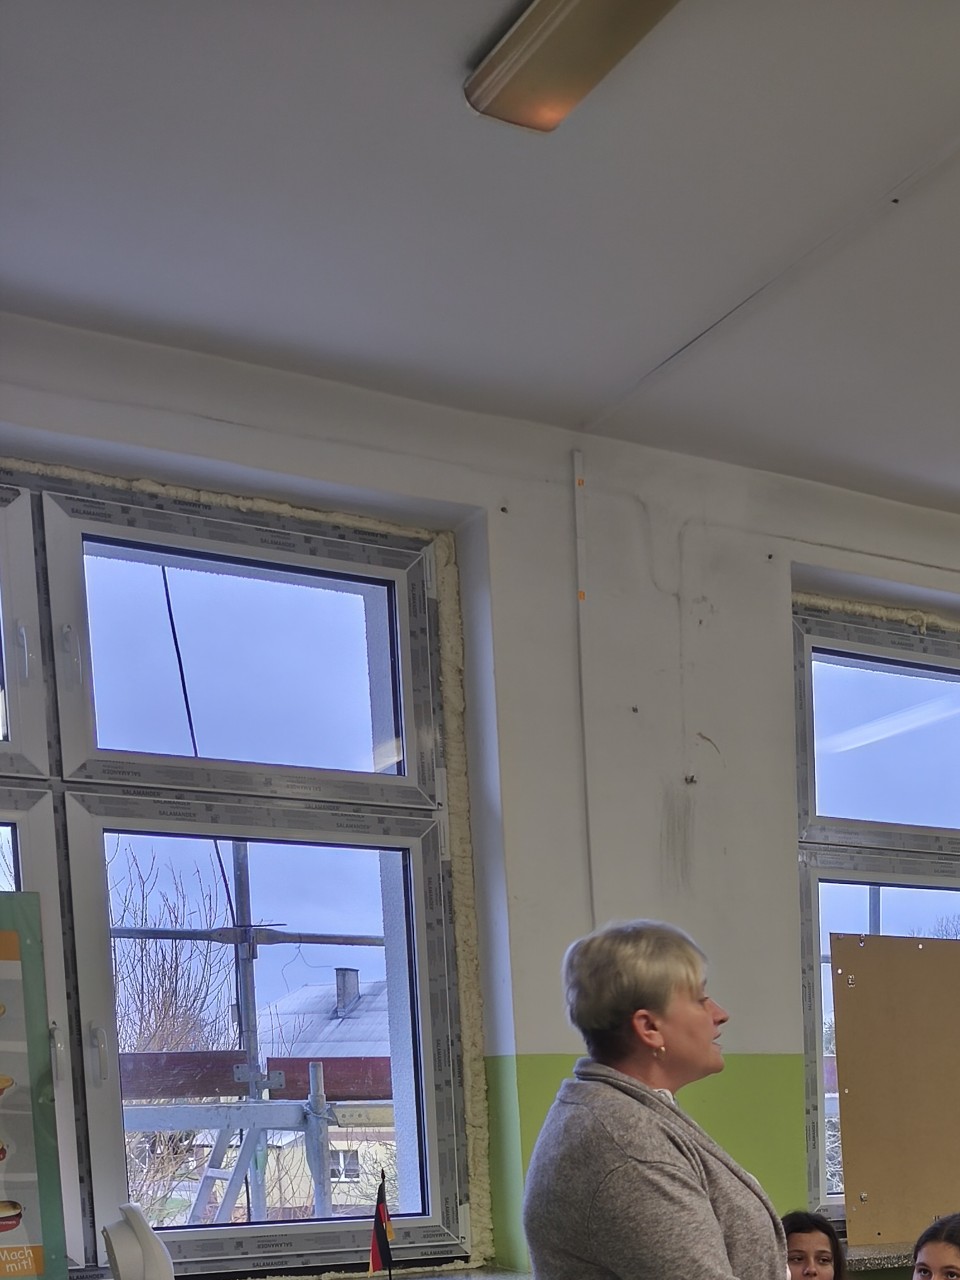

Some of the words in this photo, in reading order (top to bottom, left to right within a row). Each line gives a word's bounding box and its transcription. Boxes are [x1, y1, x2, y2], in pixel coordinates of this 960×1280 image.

[122, 789, 162, 798] SALAMANDER
[159, 810, 197, 819] SALAMANDER
[0, 1246, 33, 1261] Mach
[6, 1257, 32, 1272] mit!
[252, 1260, 289, 1268] SALAMANDER
